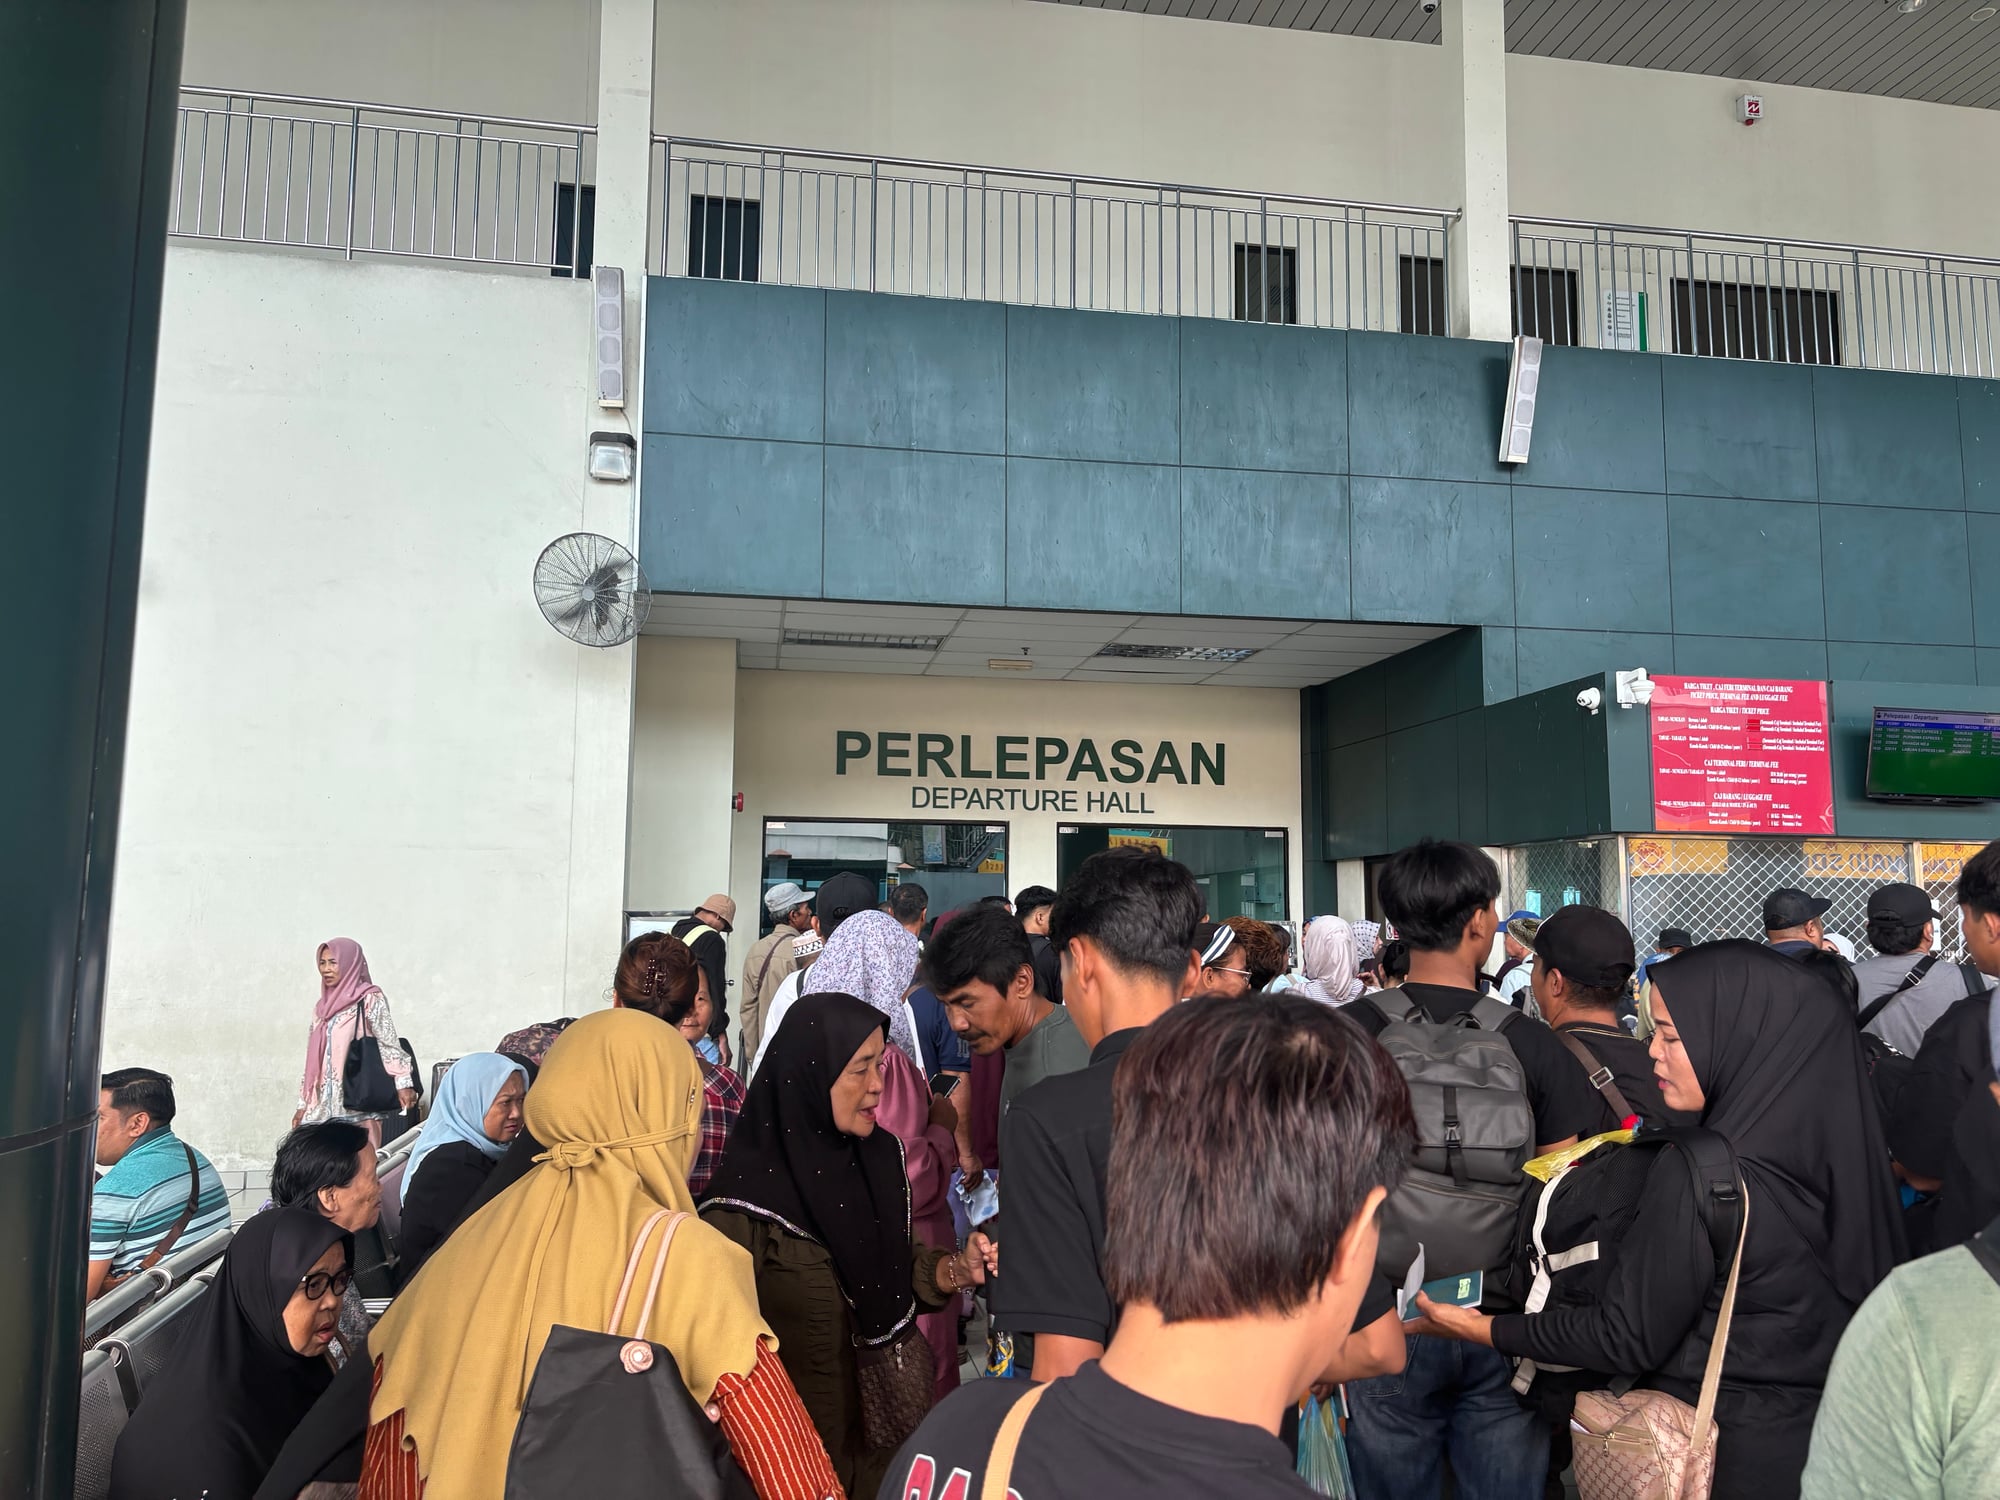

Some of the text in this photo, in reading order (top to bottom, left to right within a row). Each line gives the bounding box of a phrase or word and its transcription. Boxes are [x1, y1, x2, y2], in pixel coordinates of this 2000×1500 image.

[836, 730, 1225, 786] PERLEPASAN
[912, 787, 1155, 814] DEPARTURE HALL
